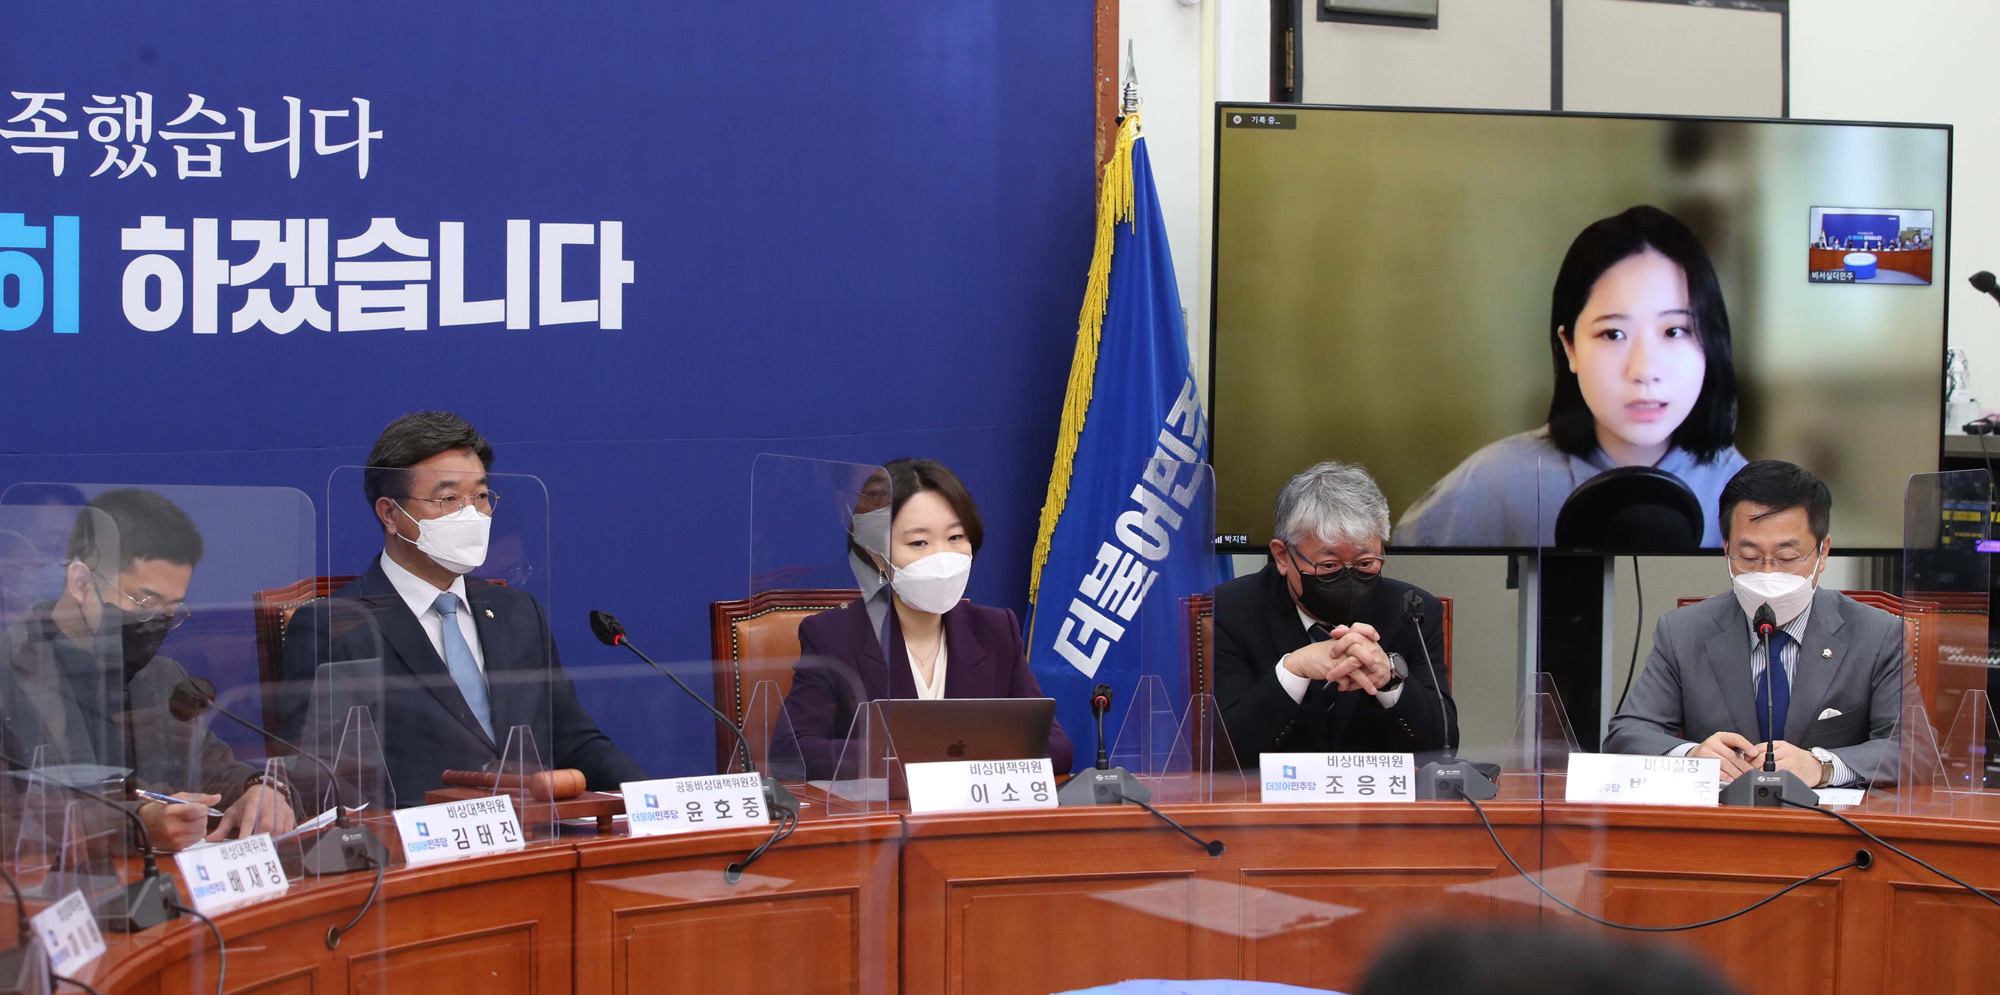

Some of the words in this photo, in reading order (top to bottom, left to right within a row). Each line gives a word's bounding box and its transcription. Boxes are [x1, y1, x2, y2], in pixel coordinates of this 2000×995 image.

[121, 216, 634, 334] 하겠습니다
[1053, 363, 1209, 679] 더불어민주
[1224, 535, 1247, 544] 박지현
[970, 761, 1042, 775] 비상대책위원
[1327, 755, 1404, 768] 비상대책위원
[1644, 758, 1700, 773] 비서실장
[675, 776, 758, 793] 공동비상대책위원장
[1265, 781, 1317, 791] 더불어민주당
[446, 799, 506, 819] 비상대책위원
[632, 810, 679, 822] 더불어민주당
[220, 838, 268, 860] 비상대책위원
